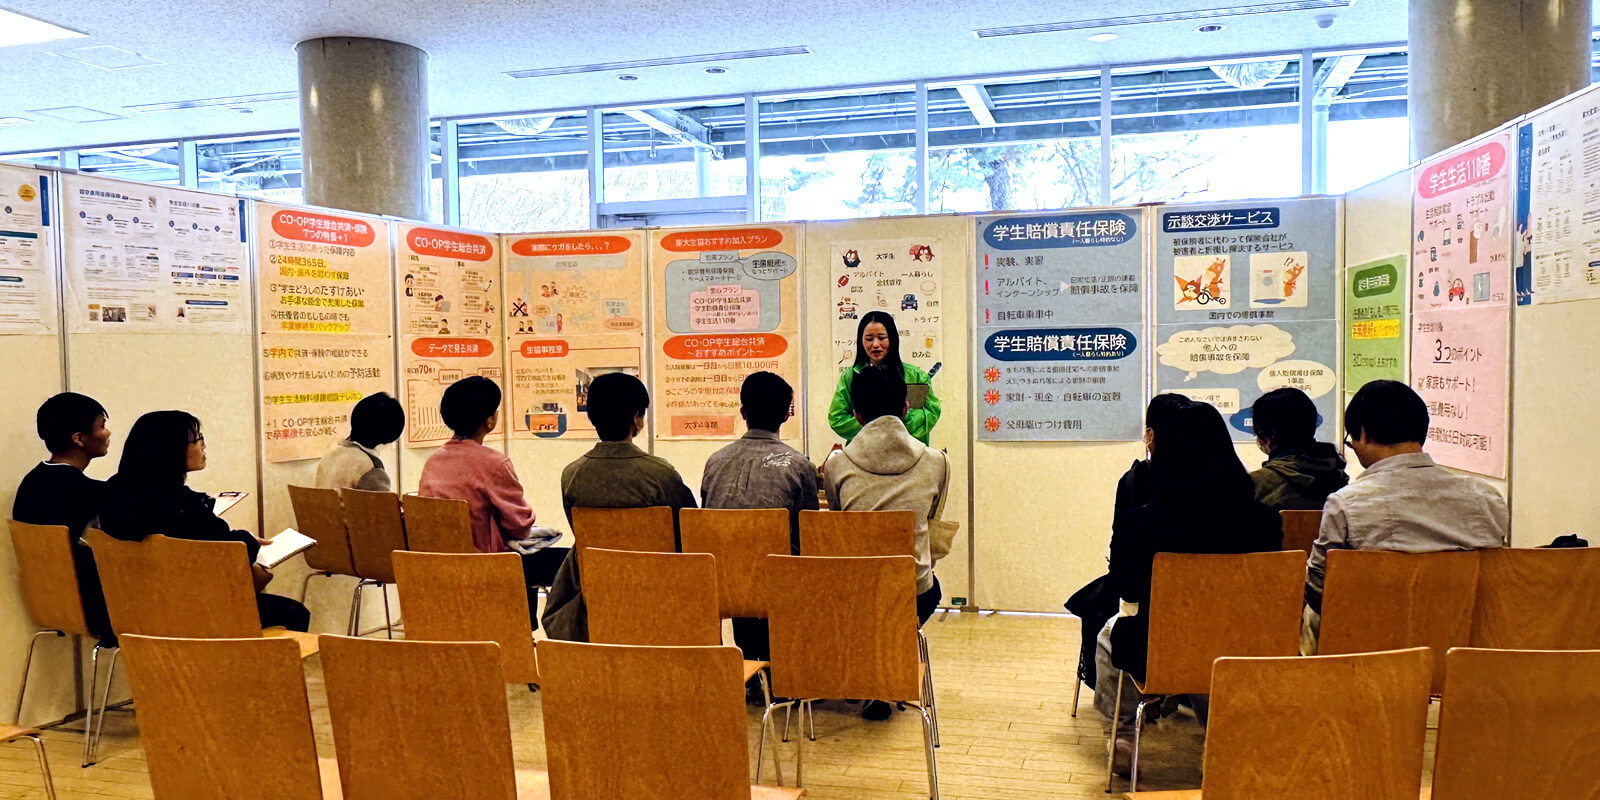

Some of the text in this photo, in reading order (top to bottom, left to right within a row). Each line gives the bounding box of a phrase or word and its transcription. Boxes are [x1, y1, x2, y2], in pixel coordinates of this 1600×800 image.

[1429, 152, 1491, 193] 学生生活110番
[1168, 211, 1274, 227] 示談交渉サービス
[993, 219, 1126, 241] 学生賠償責任保険
[996, 288, 1060, 298] インターンシップ
[994, 334, 1126, 352] 学生賠償責任保険
